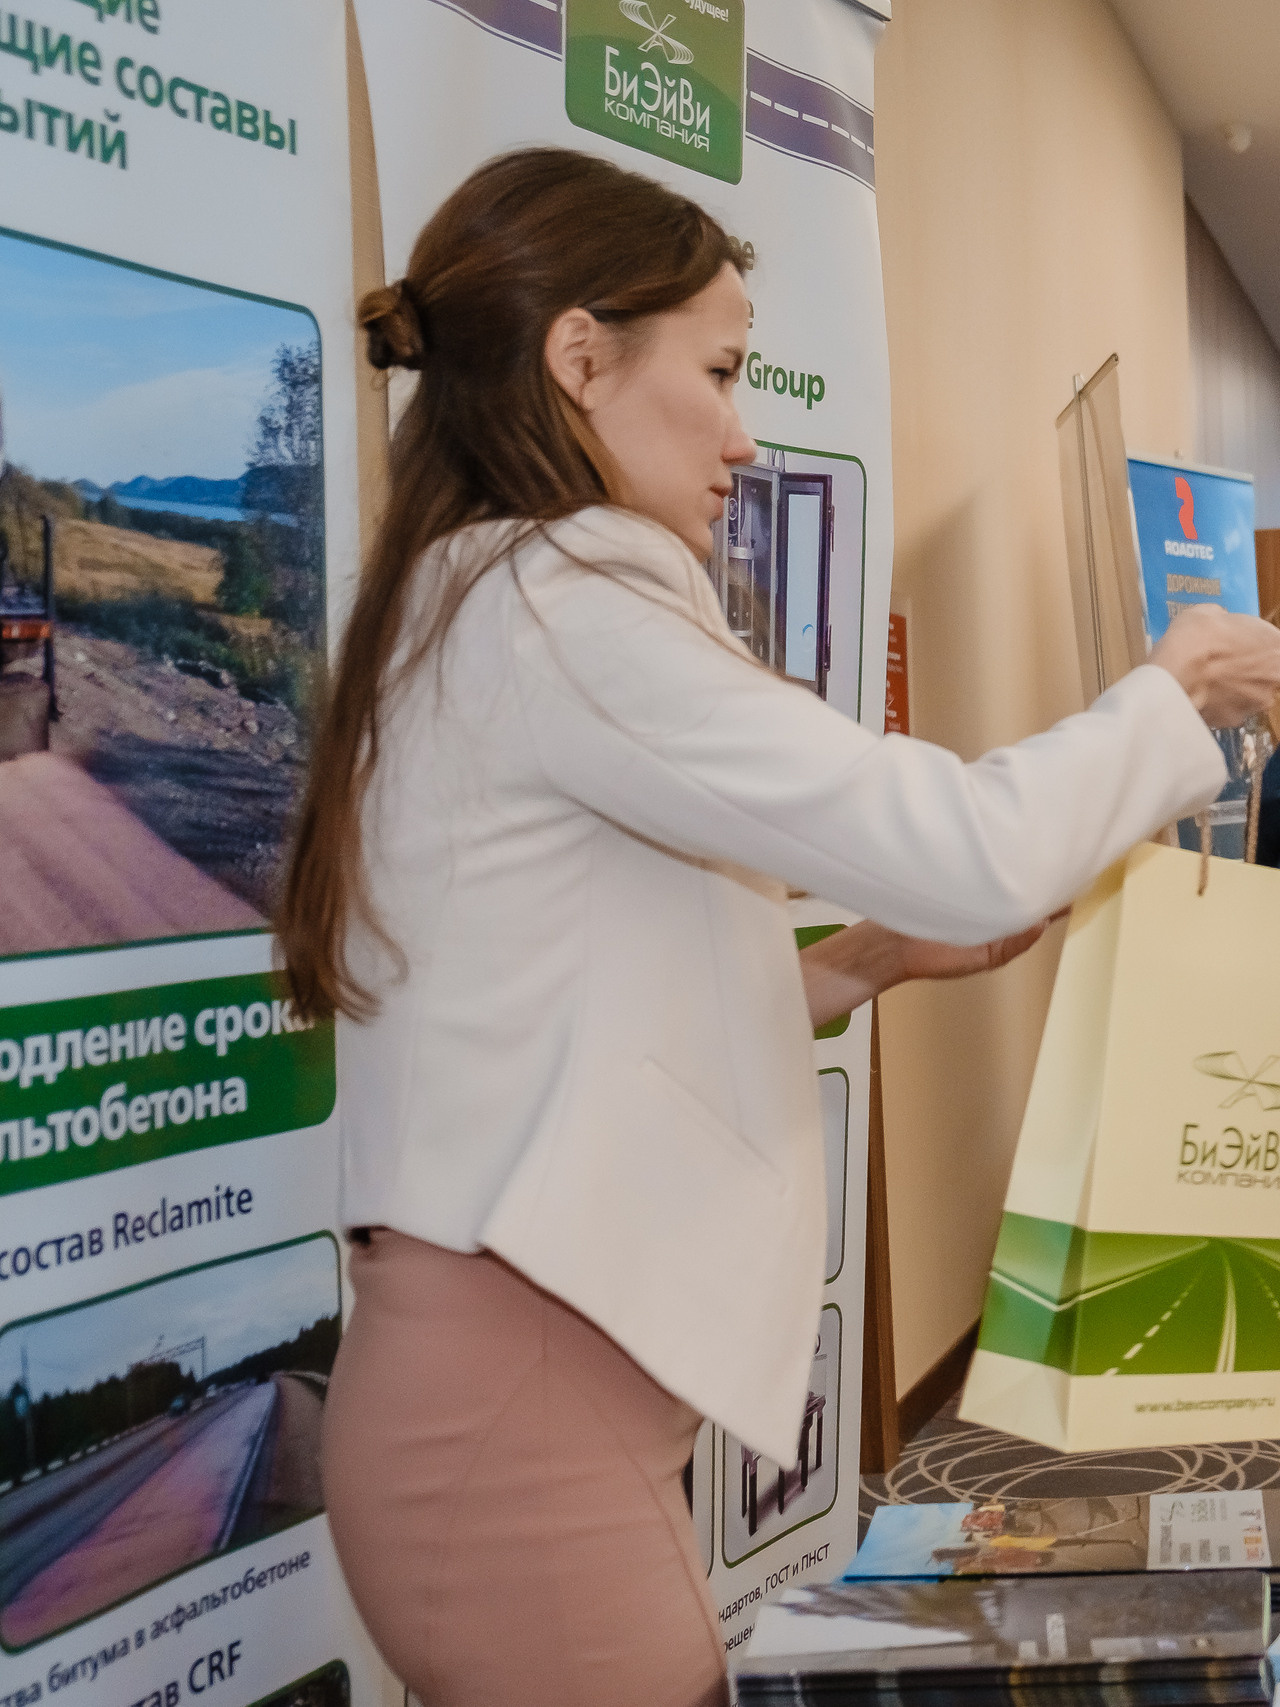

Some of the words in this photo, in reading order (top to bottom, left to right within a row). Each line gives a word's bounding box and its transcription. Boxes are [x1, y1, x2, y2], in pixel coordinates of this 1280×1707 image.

[114, 55, 297, 156] составы
[746, 351, 826, 411] Group
[0, 1012, 188, 1089] одление
[194, 1000, 314, 1057] срок
[112, 1185, 254, 1251] Reclamite
[134, 1630, 147, 1650] в
[150, 1550, 312, 1634] асфальтобетоне
[765, 1564, 791, 1594] ГОСТ
[792, 1562, 800, 1577] и
[801, 1543, 831, 1571] ПНСТ
[187, 1640, 243, 1695] CRF
